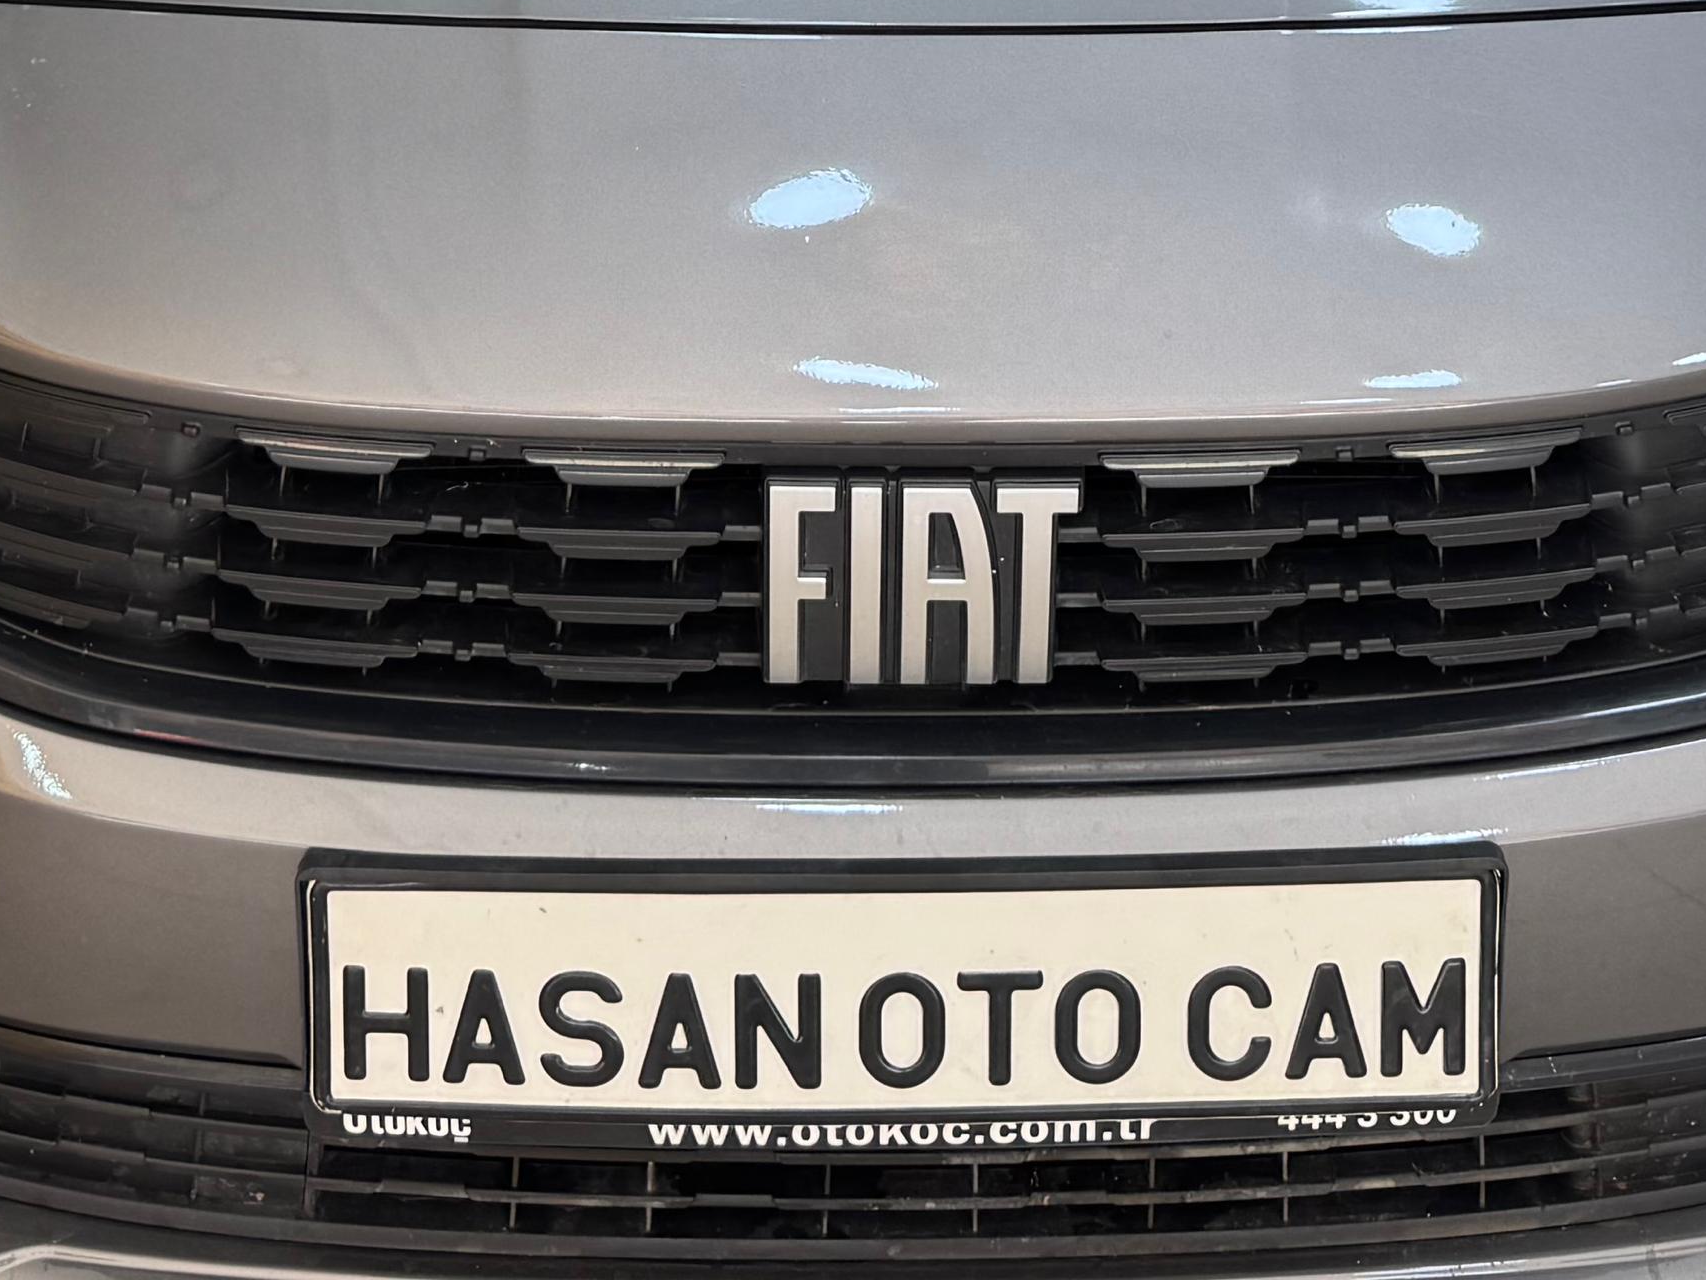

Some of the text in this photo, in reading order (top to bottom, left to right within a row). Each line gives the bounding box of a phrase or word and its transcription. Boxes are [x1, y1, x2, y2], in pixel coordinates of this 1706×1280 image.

[768, 485, 1080, 684] FIAT
[342, 958, 1466, 1089] HASAN OTO CAM
